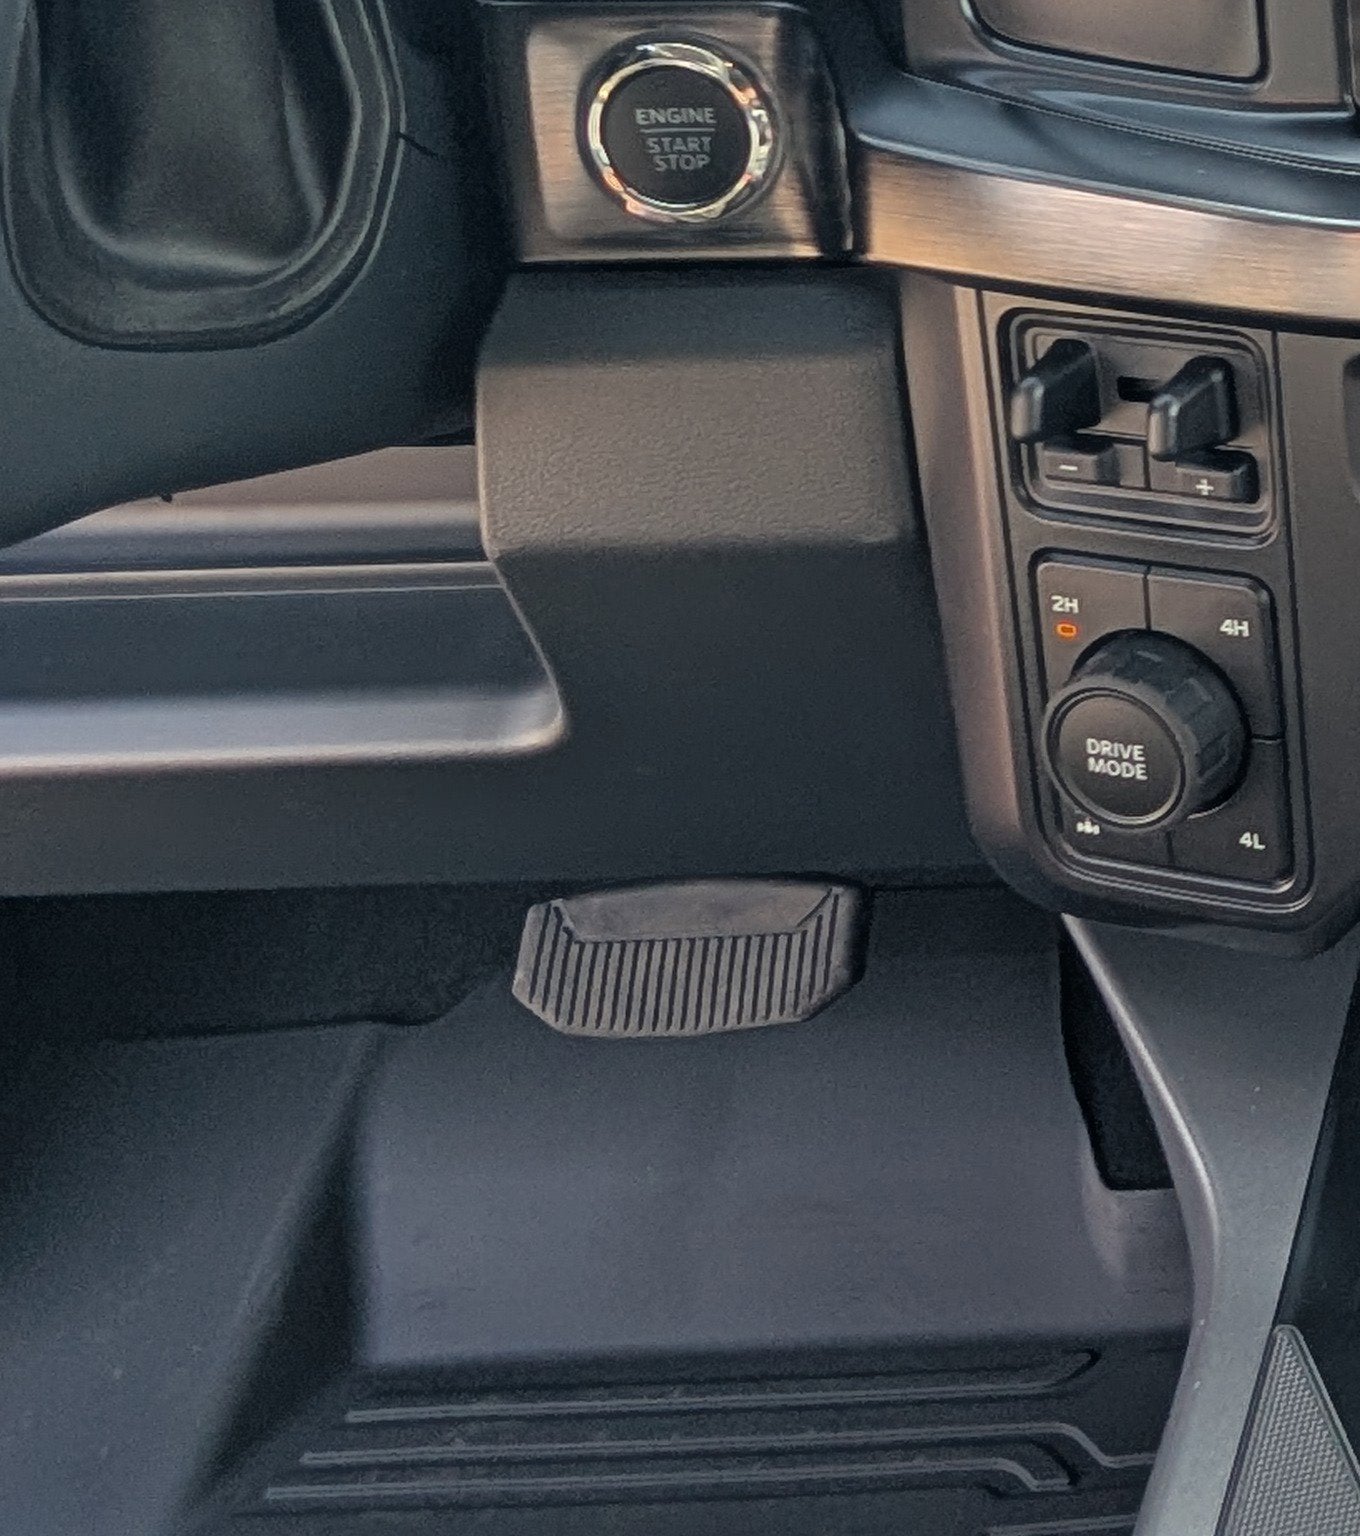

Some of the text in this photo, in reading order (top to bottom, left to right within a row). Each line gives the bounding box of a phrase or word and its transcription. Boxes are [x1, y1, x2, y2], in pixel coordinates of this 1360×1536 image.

[635, 107, 717, 126] ENGINE
[648, 137, 712, 154] START
[655, 154, 711, 172] STOP
[1051, 595, 1079, 614] 2H
[1219, 619, 1250, 637] 4H
[1086, 738, 1146, 762] DRIVE
[1087, 757, 1148, 781] MODE
[1238, 831, 1266, 850] 4L
